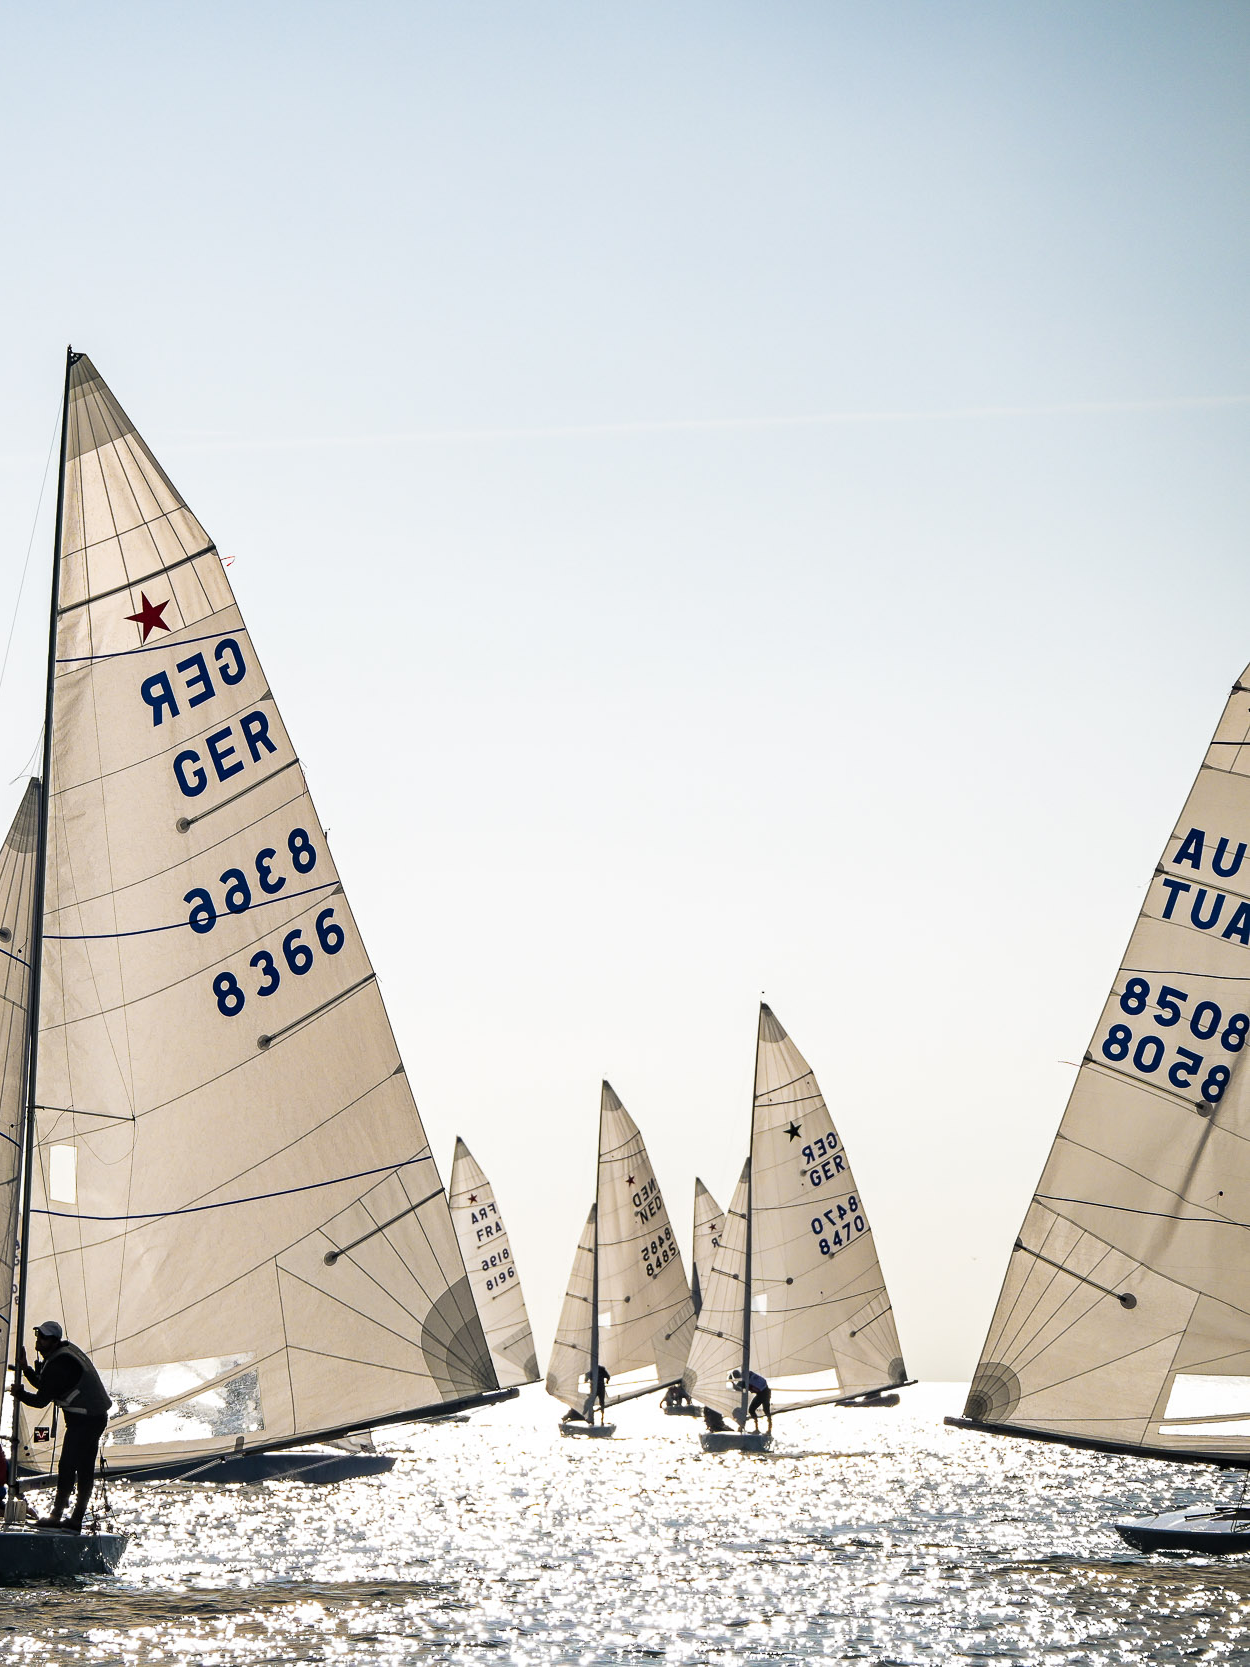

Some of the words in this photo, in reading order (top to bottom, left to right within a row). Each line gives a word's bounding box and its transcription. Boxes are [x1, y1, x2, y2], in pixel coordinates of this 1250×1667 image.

[173, 710, 277, 797] GER
[1172, 827, 1248, 878] AU
[213, 908, 345, 1017] 8366
[1120, 977, 1250, 1053] 8508
[810, 1155, 845, 1186] GER
[640, 1195, 663, 1224] NED
[476, 1221, 502, 1242] FRA
[819, 1215, 864, 1255] 8470
[646, 1241, 676, 1276] 8485
[486, 1267, 514, 1291] 8196
